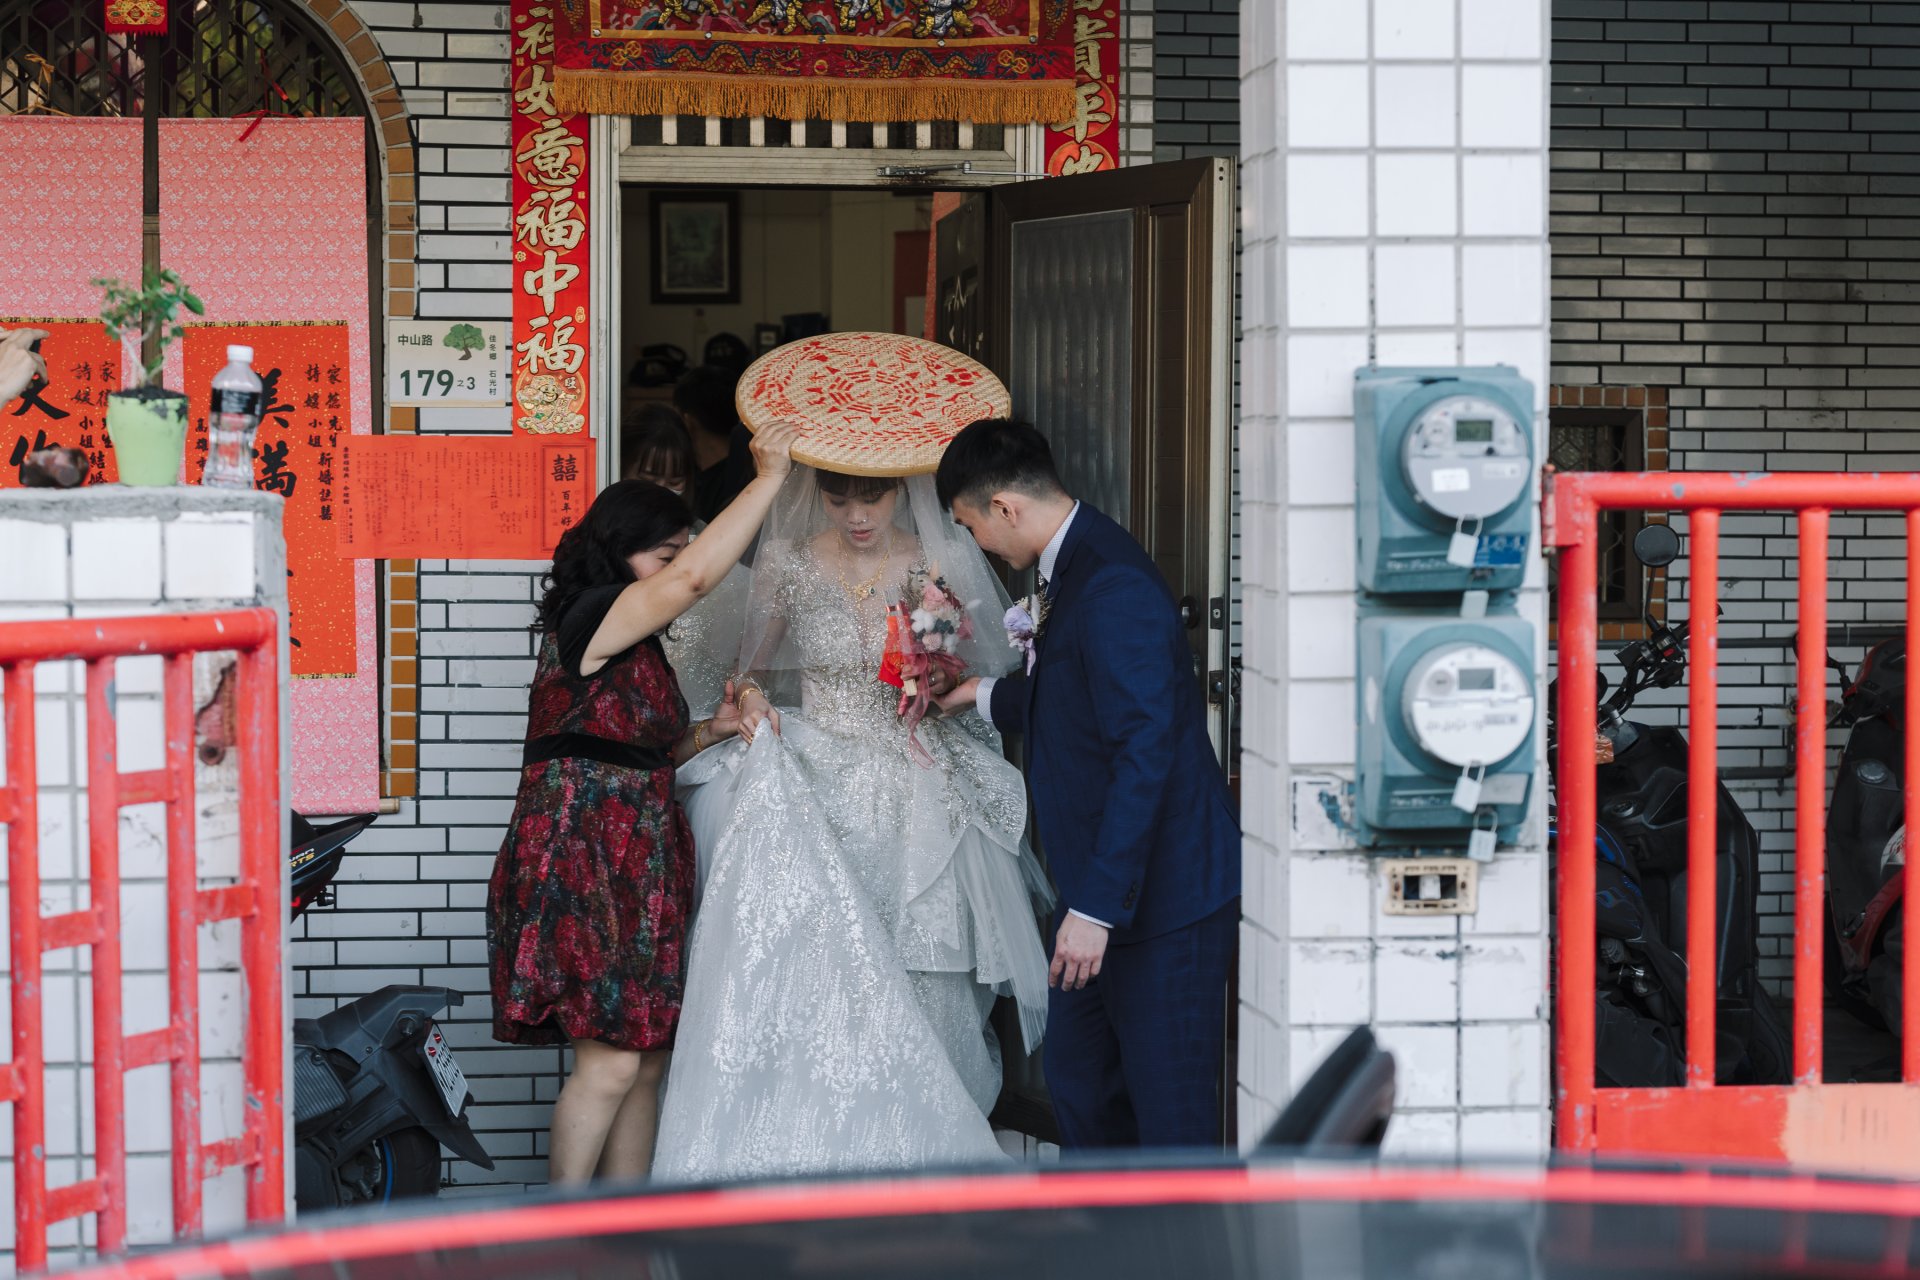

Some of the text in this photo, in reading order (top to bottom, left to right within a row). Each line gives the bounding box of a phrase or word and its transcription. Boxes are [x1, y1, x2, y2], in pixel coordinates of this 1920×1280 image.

[397, 333, 433, 347] 中山路
[488, 369, 497, 396] 石光村
[560, 490, 573, 527] 百年好
